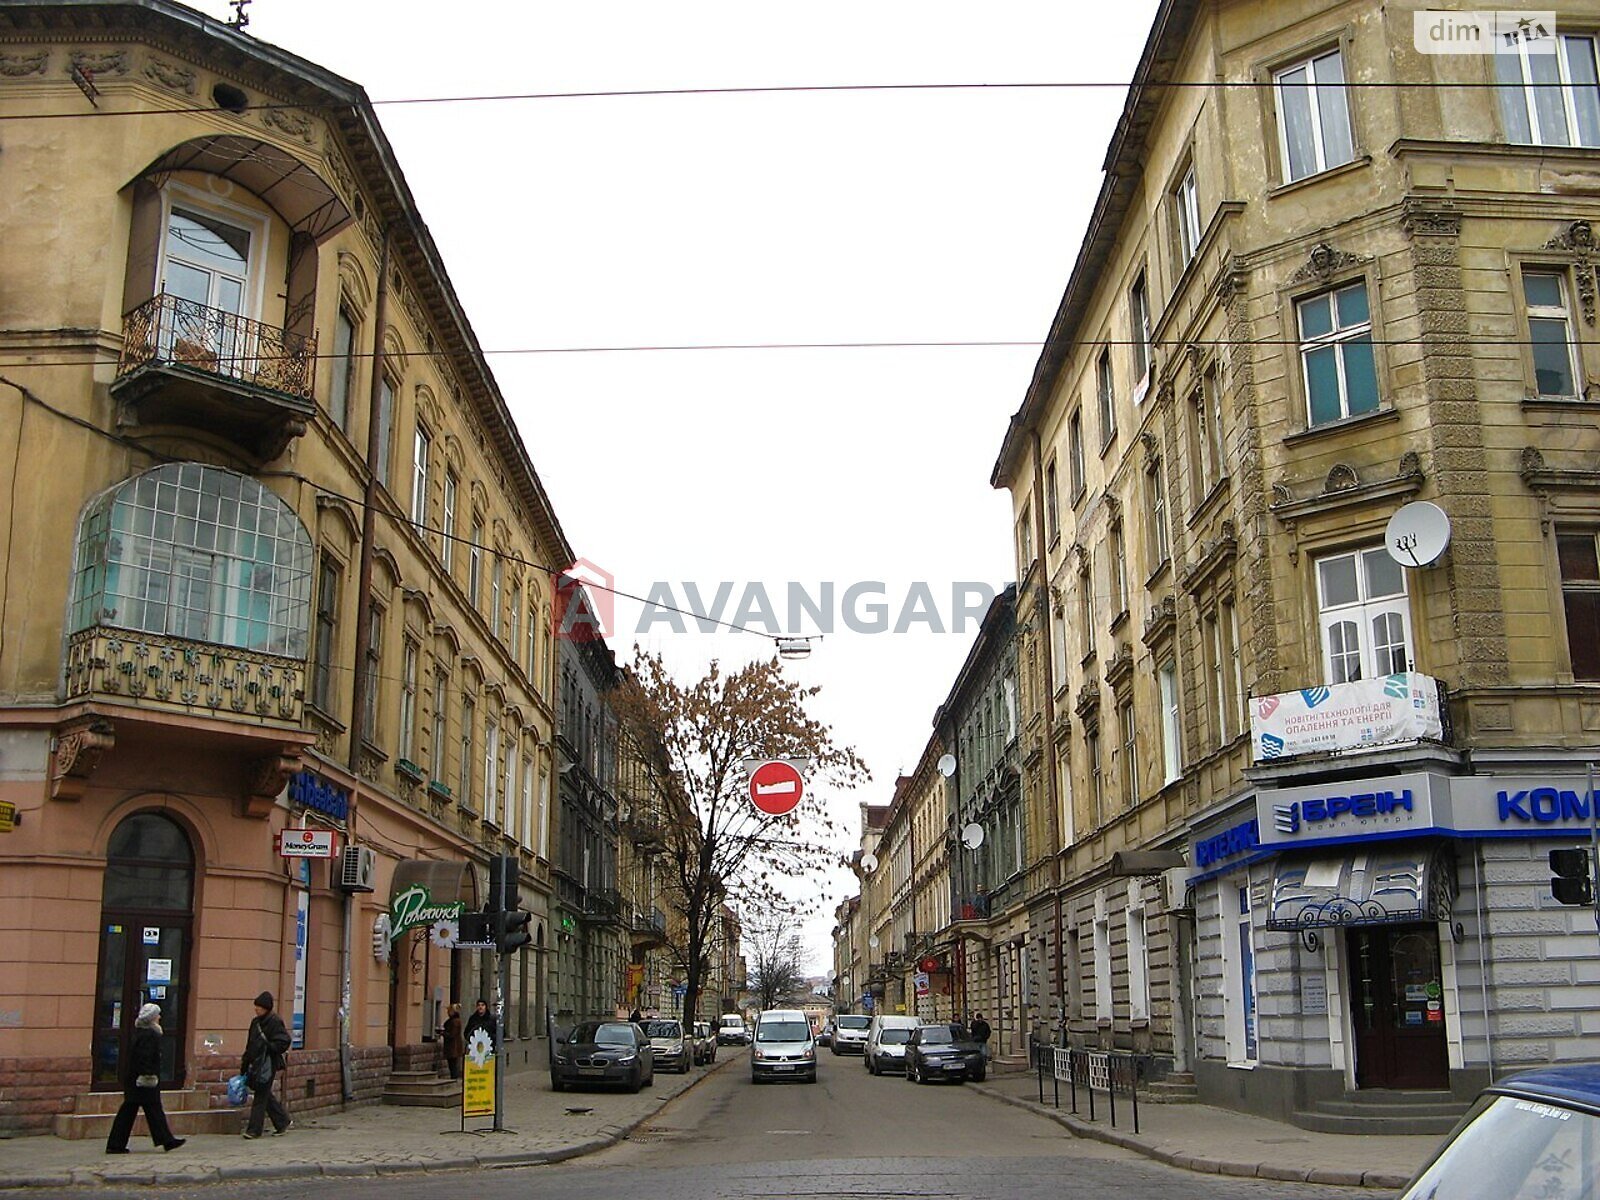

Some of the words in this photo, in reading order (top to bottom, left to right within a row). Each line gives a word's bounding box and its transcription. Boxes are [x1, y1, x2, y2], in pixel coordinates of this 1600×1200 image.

[1285, 720, 1338, 735] ОПАЛЕННЯ
[1341, 718, 1354, 726] ТА
[284, 842, 328, 851] MoneyGram
